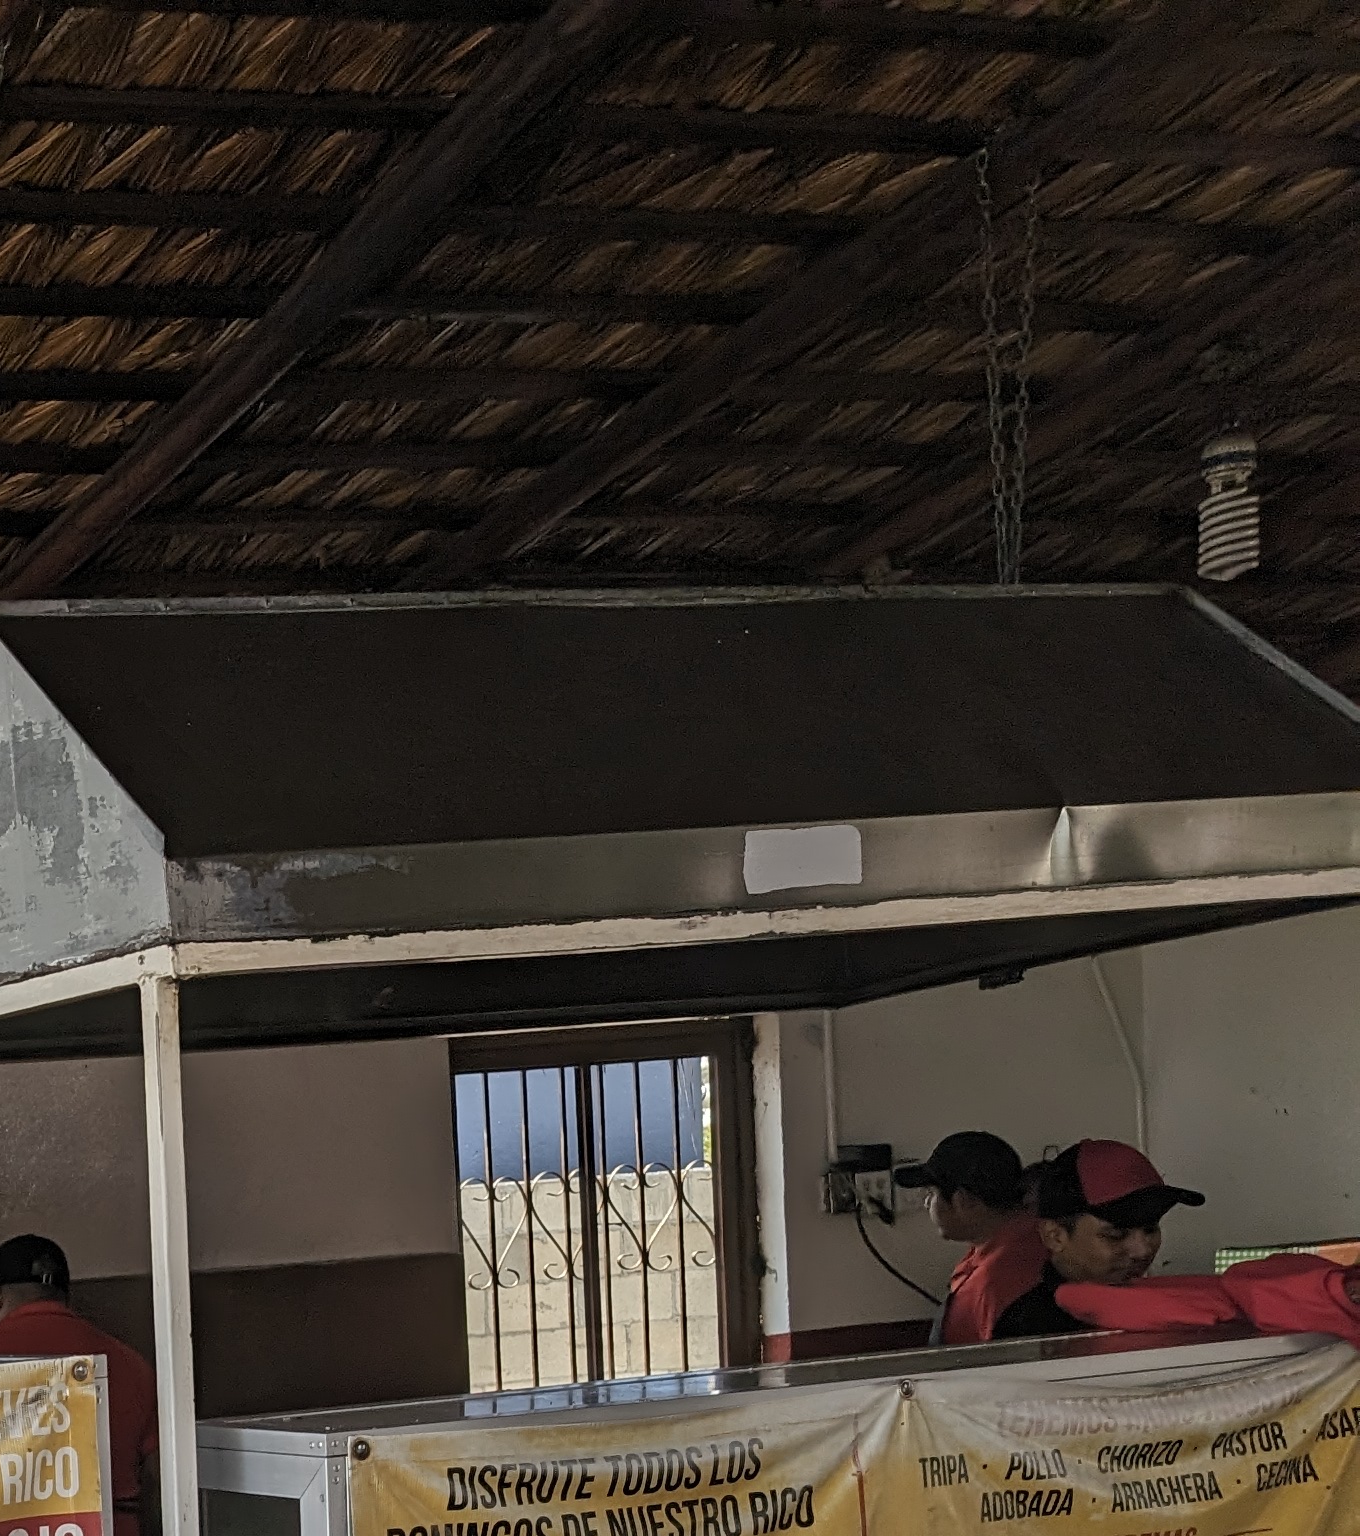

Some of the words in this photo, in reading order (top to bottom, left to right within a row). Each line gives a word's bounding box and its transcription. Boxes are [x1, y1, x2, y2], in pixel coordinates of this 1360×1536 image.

[2, 1447, 81, 1503] RICO
[447, 1459, 593, 1511] DISFRUTE
[606, 1446, 700, 1497] TODOS
[710, 1437, 764, 1484] LOS
[919, 1453, 969, 1488] TRIPA
[1005, 1448, 1068, 1482] POLLO
[1097, 1439, 1184, 1475] CHORIZO
[1211, 1422, 1288, 1460] PASTOR
[752, 1485, 815, 1535] RICO
[981, 1487, 1074, 1523] ADOBADA
[1111, 1471, 1223, 1513] ARRACHERA
